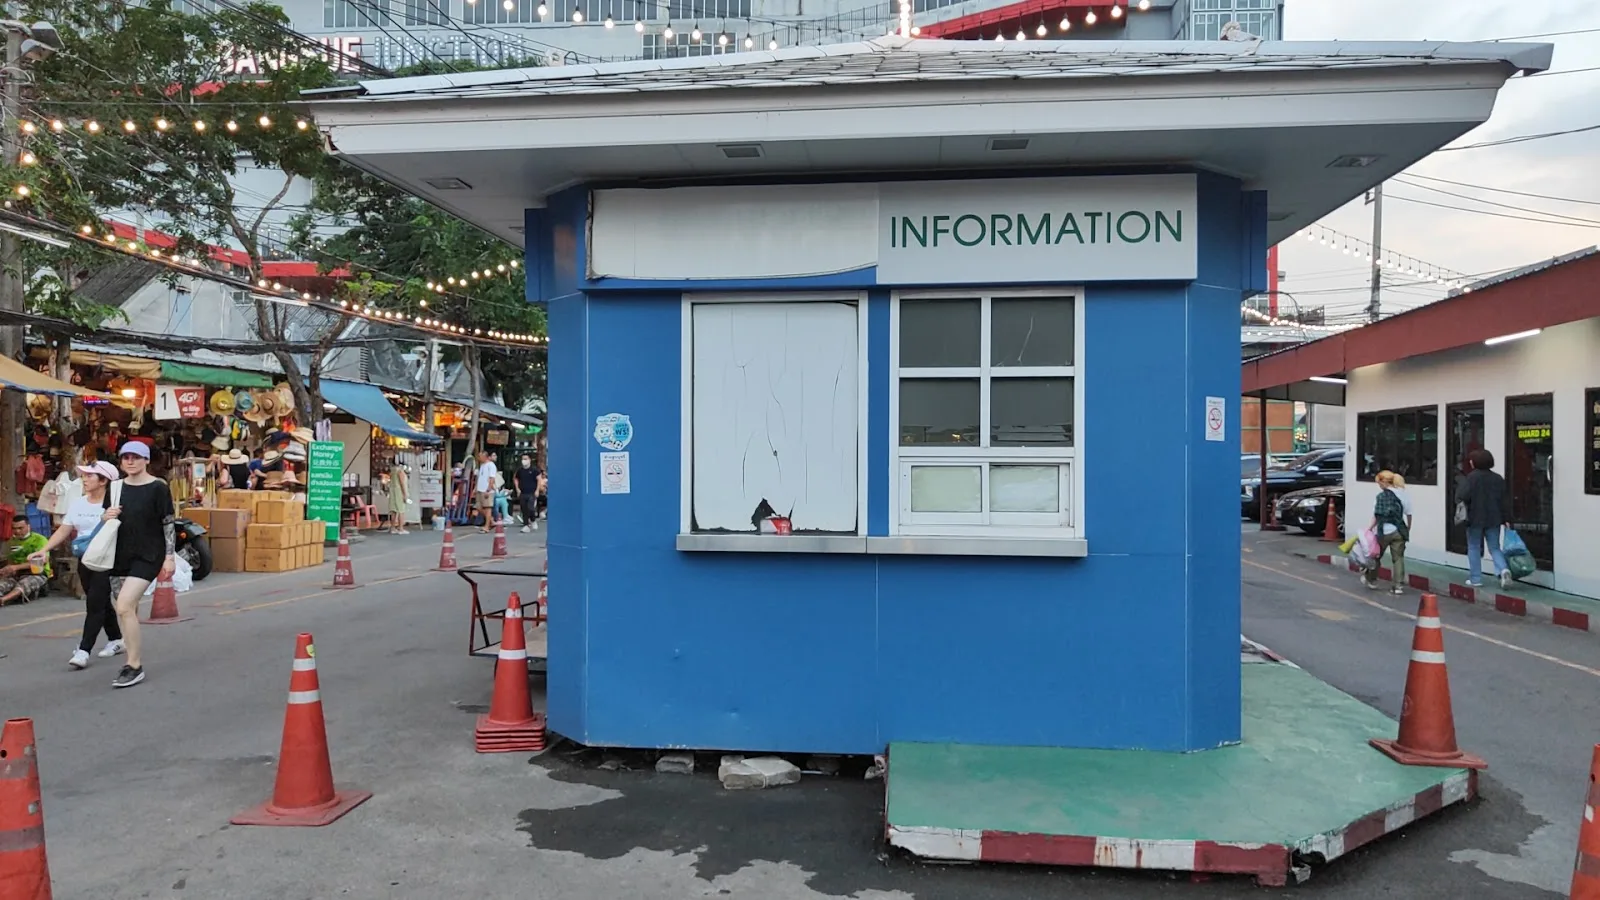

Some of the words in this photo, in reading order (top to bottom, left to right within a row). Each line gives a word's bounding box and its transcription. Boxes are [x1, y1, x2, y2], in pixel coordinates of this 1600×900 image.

[891, 209, 1183, 248] INFORMATION
[160, 391, 167, 411] 1
[1518, 430, 1540, 438] GUARD
[1541, 429, 1550, 437] 24
[311, 443, 343, 452] Exchange
[312, 451, 335, 459] Money
